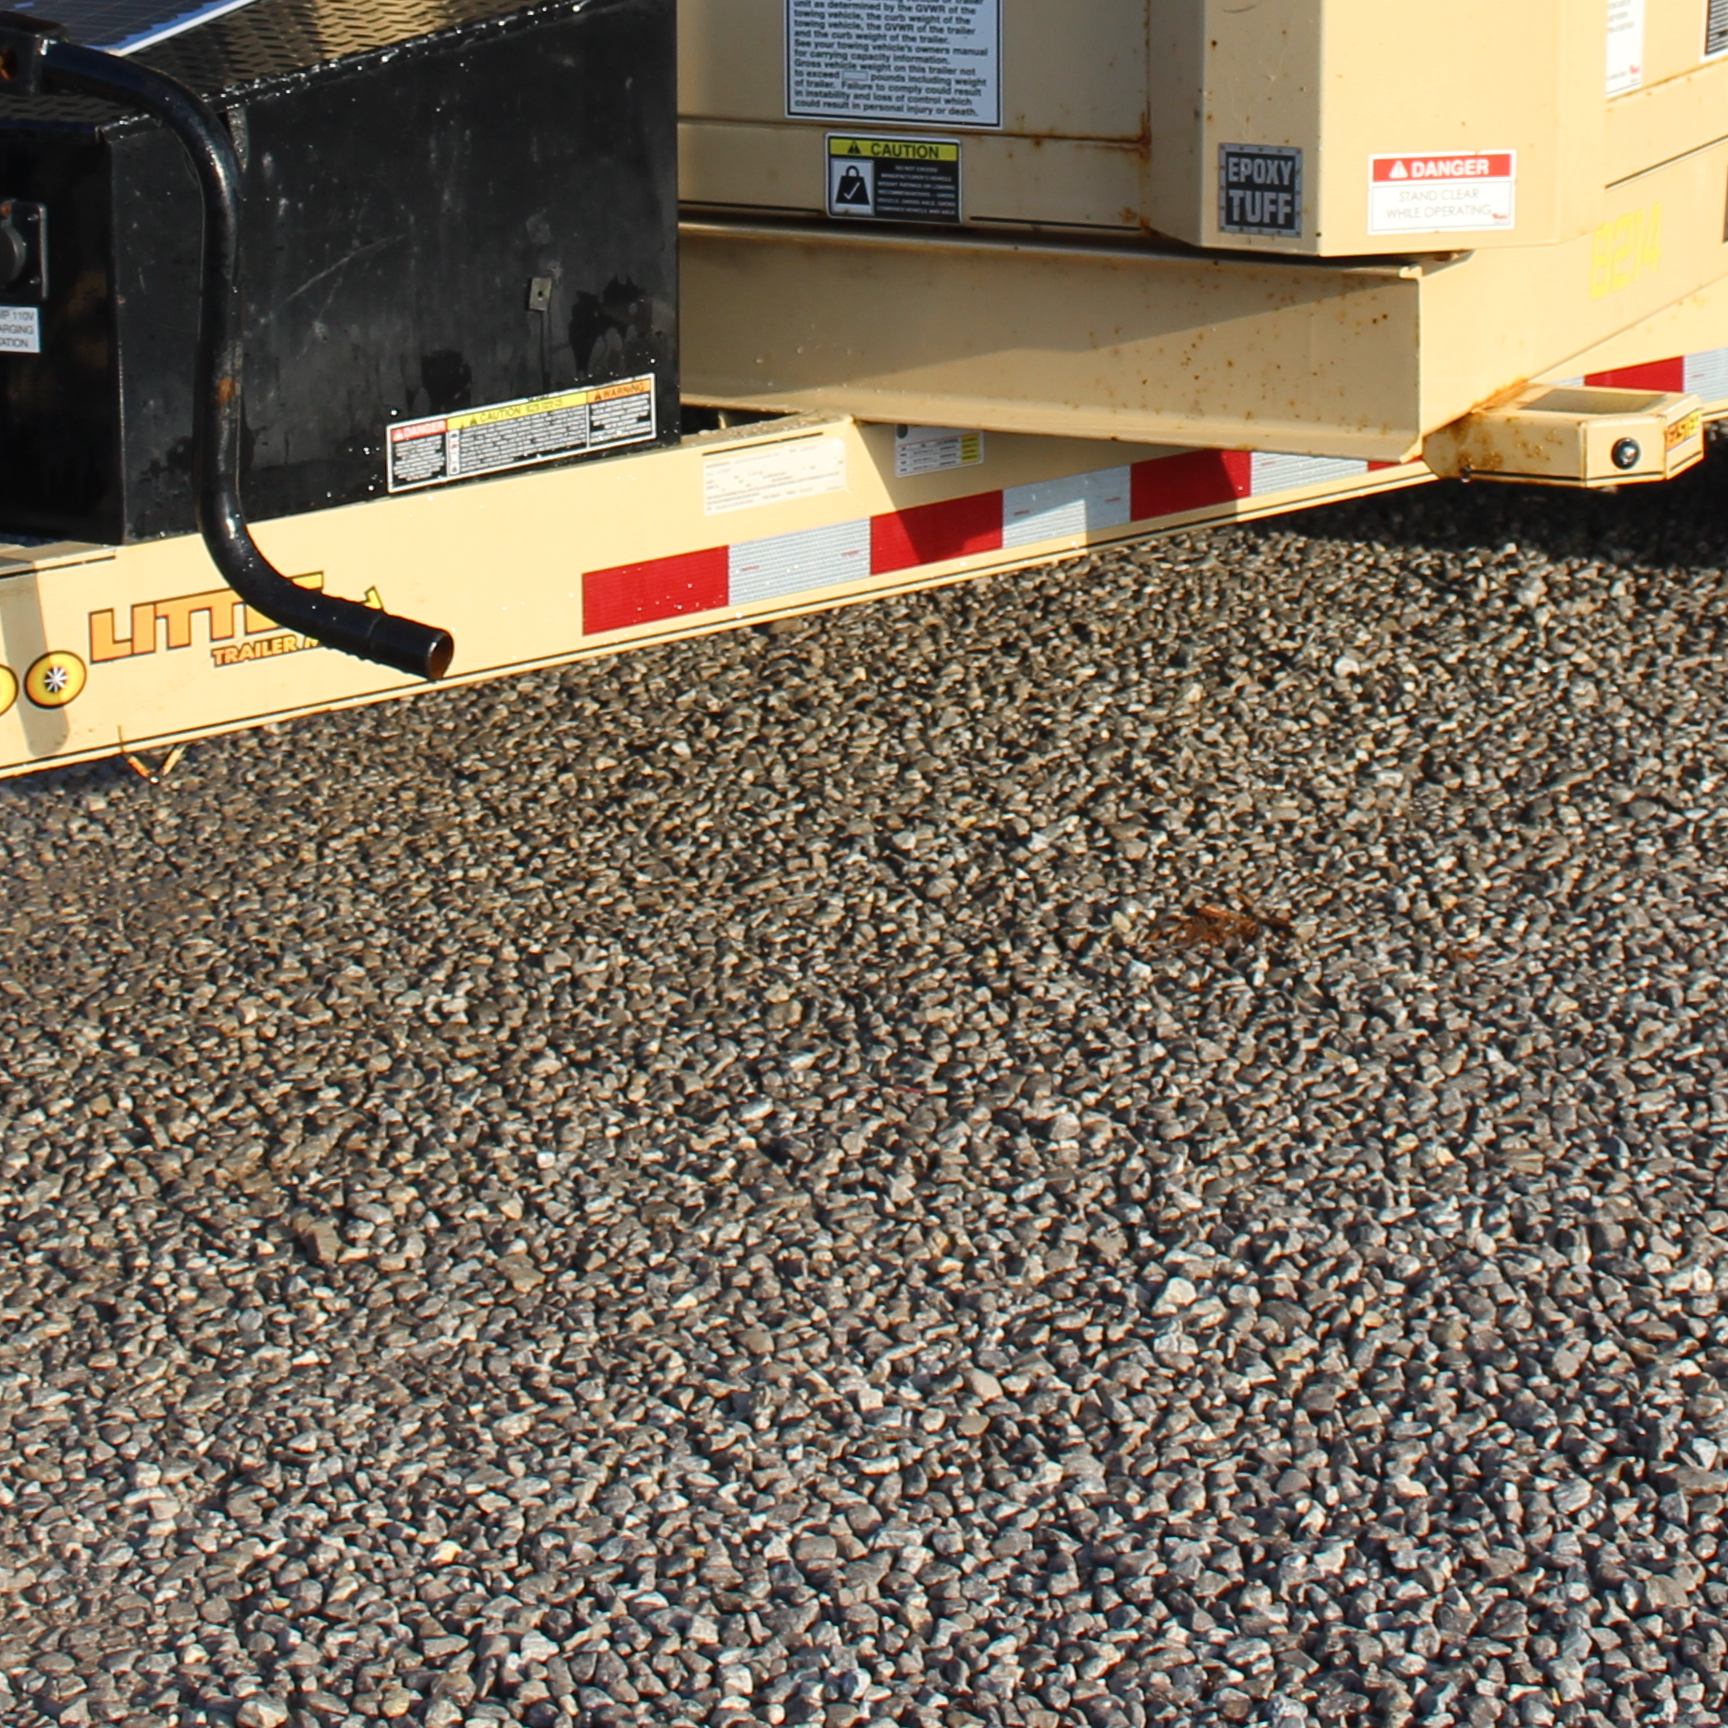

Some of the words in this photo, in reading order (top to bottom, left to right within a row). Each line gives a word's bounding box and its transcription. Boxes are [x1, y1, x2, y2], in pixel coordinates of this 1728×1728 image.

[795, 0, 811, 8] unit
[828, 1, 880, 11] determined
[884, 3, 894, 13] by
[898, 3, 912, 12] the
[916, 5, 945, 14] GVWR
[949, 6, 958, 14] of
[961, 7, 975, 15] the
[795, 10, 825, 19] towing
[828, 11, 863, 20] vehicle,
[866, 12, 881, 21] the
[885, 13, 906, 22] curb
[909, 14, 940, 25] weight
[944, 16, 953, 24] of
[956, 17, 970, 25] the
[795, 20, 825, 29] towing
[828, 21, 863, 30] vehicle,
[866, 22, 881, 31] the
[885, 23, 914, 32] GVWR
[930, 25, 944, 33] the
[947, 26, 975, 35] trailer
[795, 30, 810, 38] and
[814, 30, 828, 38] the
[832, 31, 853, 40] curb
[856, 32, 887, 42] weight
[890, 33, 900, 41] of
[902, 34, 917, 42] the
[795, 39, 811, 48] See
[814, 42, 834, 50] your
[838, 41, 869, 52] towing
[915, 46, 949, 54] owners
[953, 47, 988, 56] manual
[795, 49, 807, 57] for
[810, 51, 848, 61] carrying
[851, 53, 890, 63] capacity
[795, 59, 821, 68] Gross
[825, 60, 856, 70] vehicle
[860, 62, 891, 72] weight
[909, 64, 925, 73] this
[929, 66, 957, 74] trailer
[807, 70, 839, 79] exceed
[871, 73, 905, 82] pounds
[908, 75, 951, 85] including
[954, 77, 986, 87] weight
[841, 82, 872, 91] Failure
[889, 84, 922, 95] comply
[926, 86, 951, 95] could
[954, 88, 981, 96] result
[795, 89, 803, 97] in
[853, 92, 870, 100] and
[874, 93, 892, 101] loss
[895, 94, 905, 102] of
[908, 95, 941, 104] control
[944, 97, 971, 106] which
[795, 99, 820, 107] could
[823, 100, 849, 109] result
[864, 102, 904, 113] personal
[907, 104, 932, 115] injury
[871, 143, 939, 158] CAUTION
[1228, 156, 1294, 186] EPOXY
[1411, 159, 1490, 179] DANGER
[1399, 190, 1437, 203] STAND
[1441, 188, 1480, 201] CLEAR
[1228, 189, 1292, 225] TUFF
[1386, 207, 1421, 220] WHILE
[1424, 204, 1493, 218] OPERATING
[602, 382, 645, 400] WARNING
[479, 407, 522, 422] CAUTION
[404, 419, 446, 437] DANGER
[210, 633, 296, 668] TRAILER
